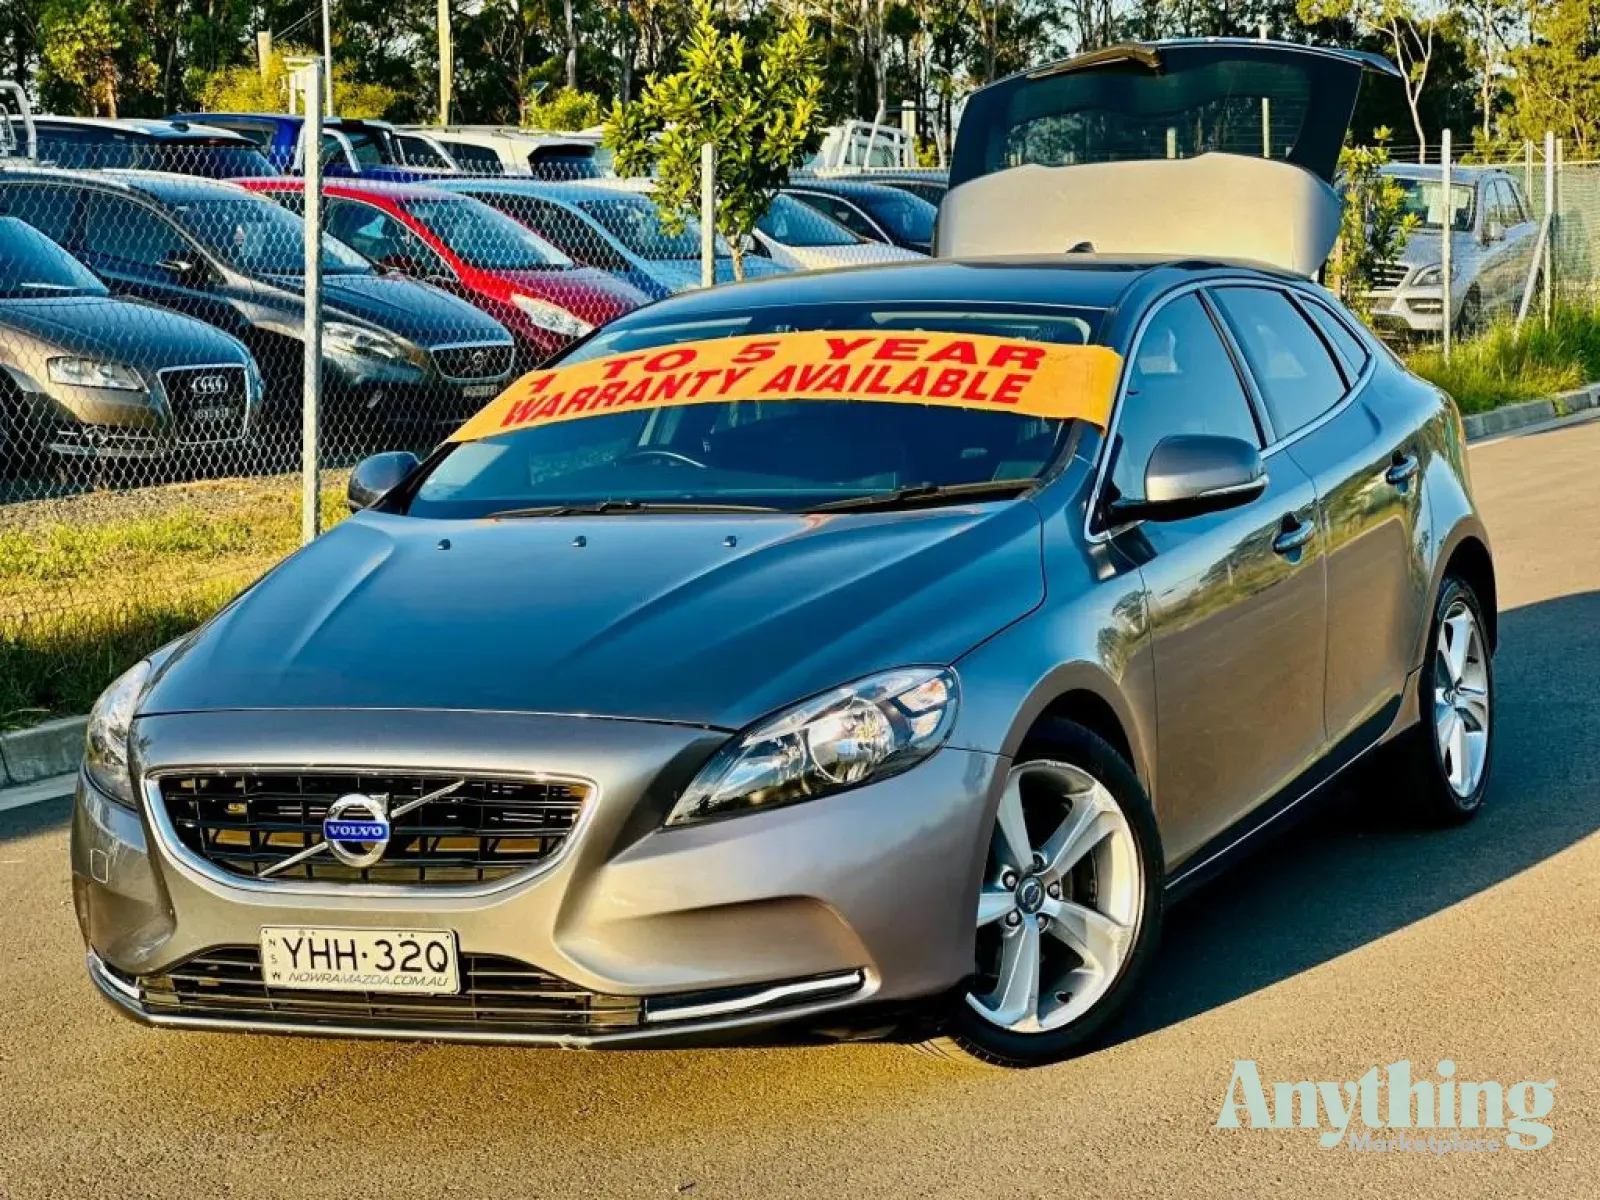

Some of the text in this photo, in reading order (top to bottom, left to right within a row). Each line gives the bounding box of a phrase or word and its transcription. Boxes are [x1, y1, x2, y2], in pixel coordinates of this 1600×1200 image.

[501, 363, 1036, 426] WARRANTY AVAILABLE
[526, 374, 557, 395] 1
[602, 349, 698, 379] TO
[731, 341, 780, 364] 5
[826, 338, 1047, 371] YEAR
[328, 825, 383, 836] VOLVO
